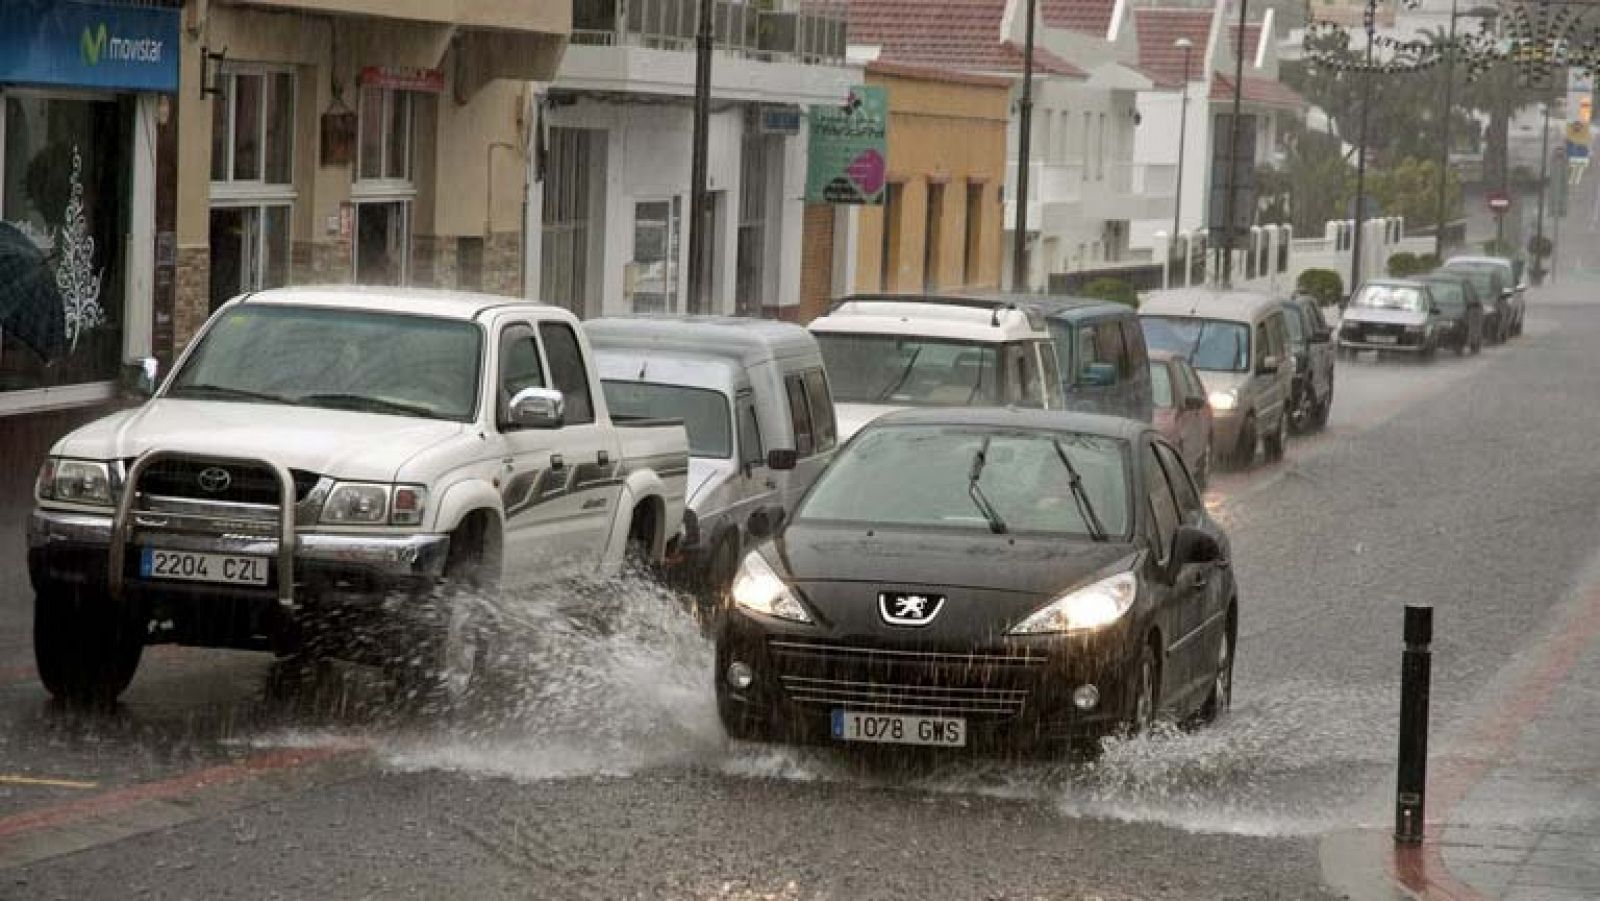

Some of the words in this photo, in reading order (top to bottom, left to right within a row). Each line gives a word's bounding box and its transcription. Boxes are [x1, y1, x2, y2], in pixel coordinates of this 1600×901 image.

[109, 37, 163, 64] movistar
[155, 552, 207, 577] 2204
[223, 558, 264, 581] CZL
[853, 716, 903, 739] 1078
[918, 719, 959, 742] GWS
